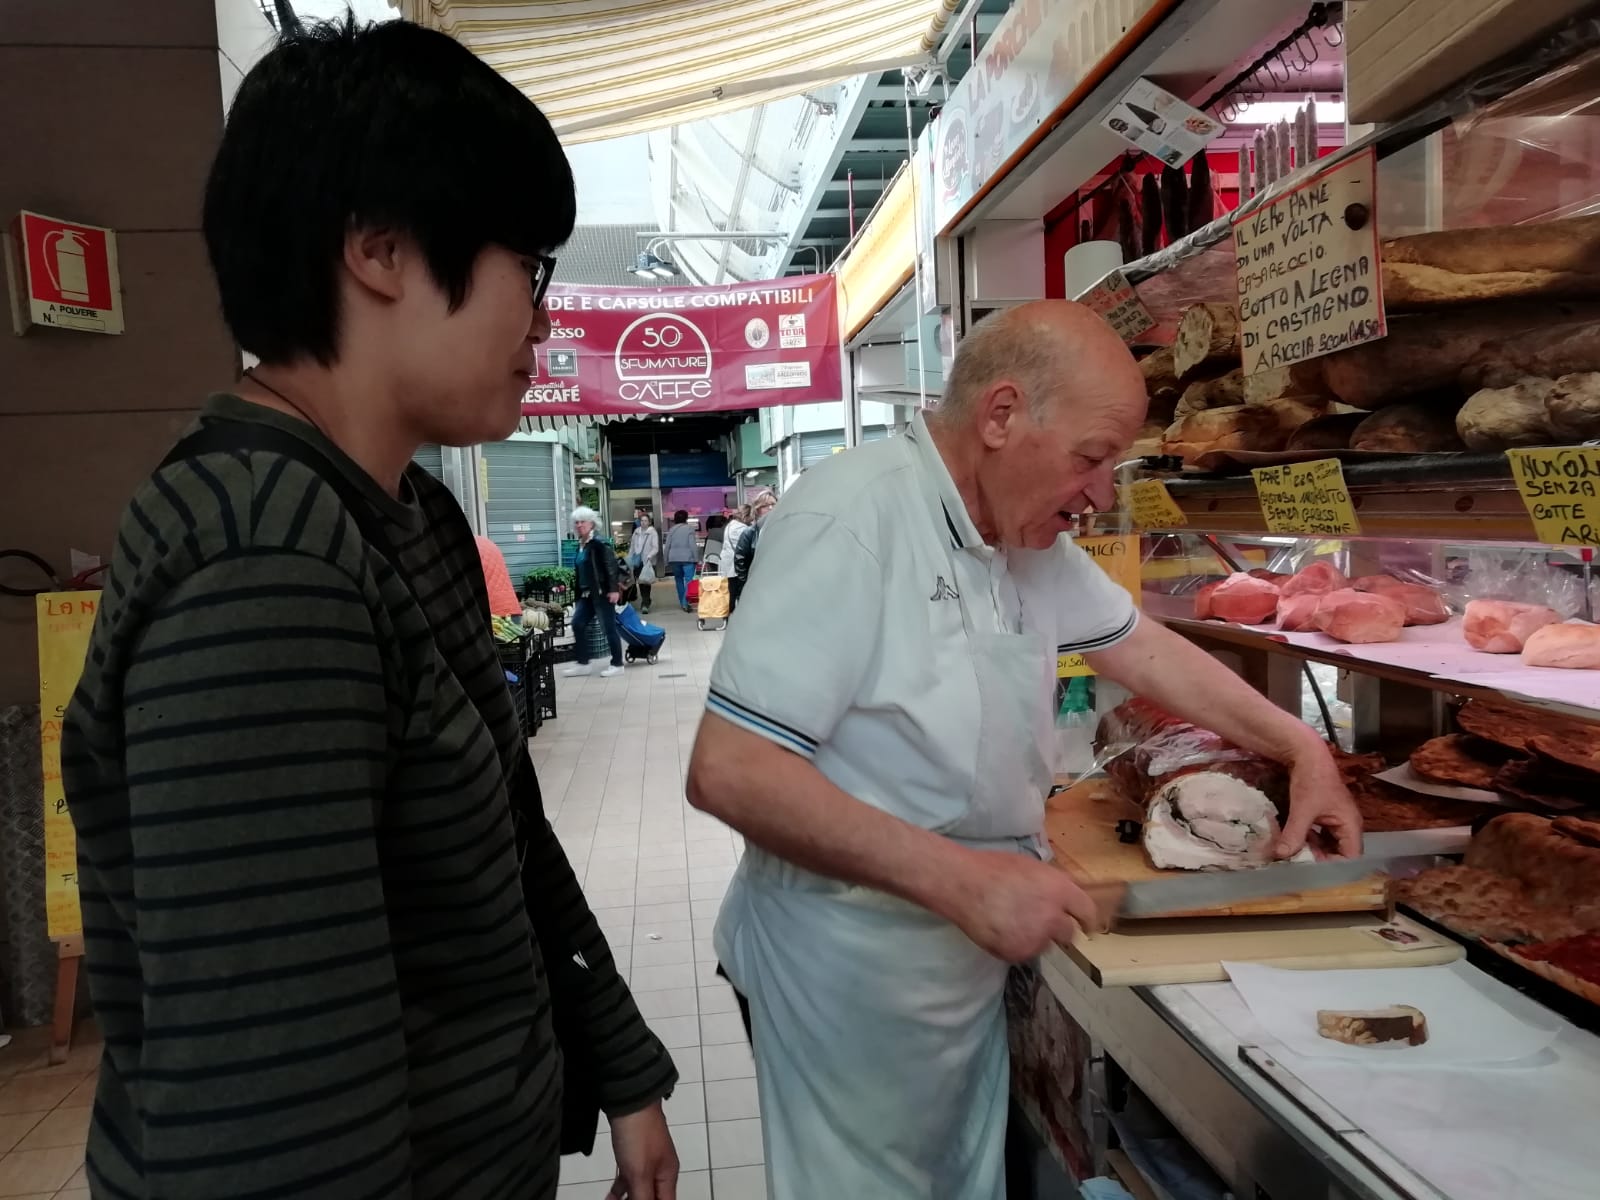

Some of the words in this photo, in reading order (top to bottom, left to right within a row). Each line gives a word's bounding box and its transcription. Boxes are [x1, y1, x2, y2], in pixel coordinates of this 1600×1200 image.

[1236, 229, 1248, 247] IL
[1252, 203, 1284, 238] VERO
[1289, 183, 1329, 218] PANE
[1253, 241, 1275, 261] UNA
[1281, 211, 1333, 247] VOLTA
[581, 296, 594, 310] E
[598, 295, 686, 310] CAPSULE
[690, 288, 813, 308] COMPATIBILI
[1240, 287, 1288, 321] COTTO
[1294, 280, 1305, 308] A
[1309, 256, 1369, 298] LEGNA
[49, 304, 56, 312] A
[59, 305, 98, 318] POLVERE
[641, 325, 682, 348] 50
[620, 355, 707, 370] SFUMATURE
[1254, 336, 1314, 374] ARICCIA
[1525, 480, 1596, 497] SENZA
